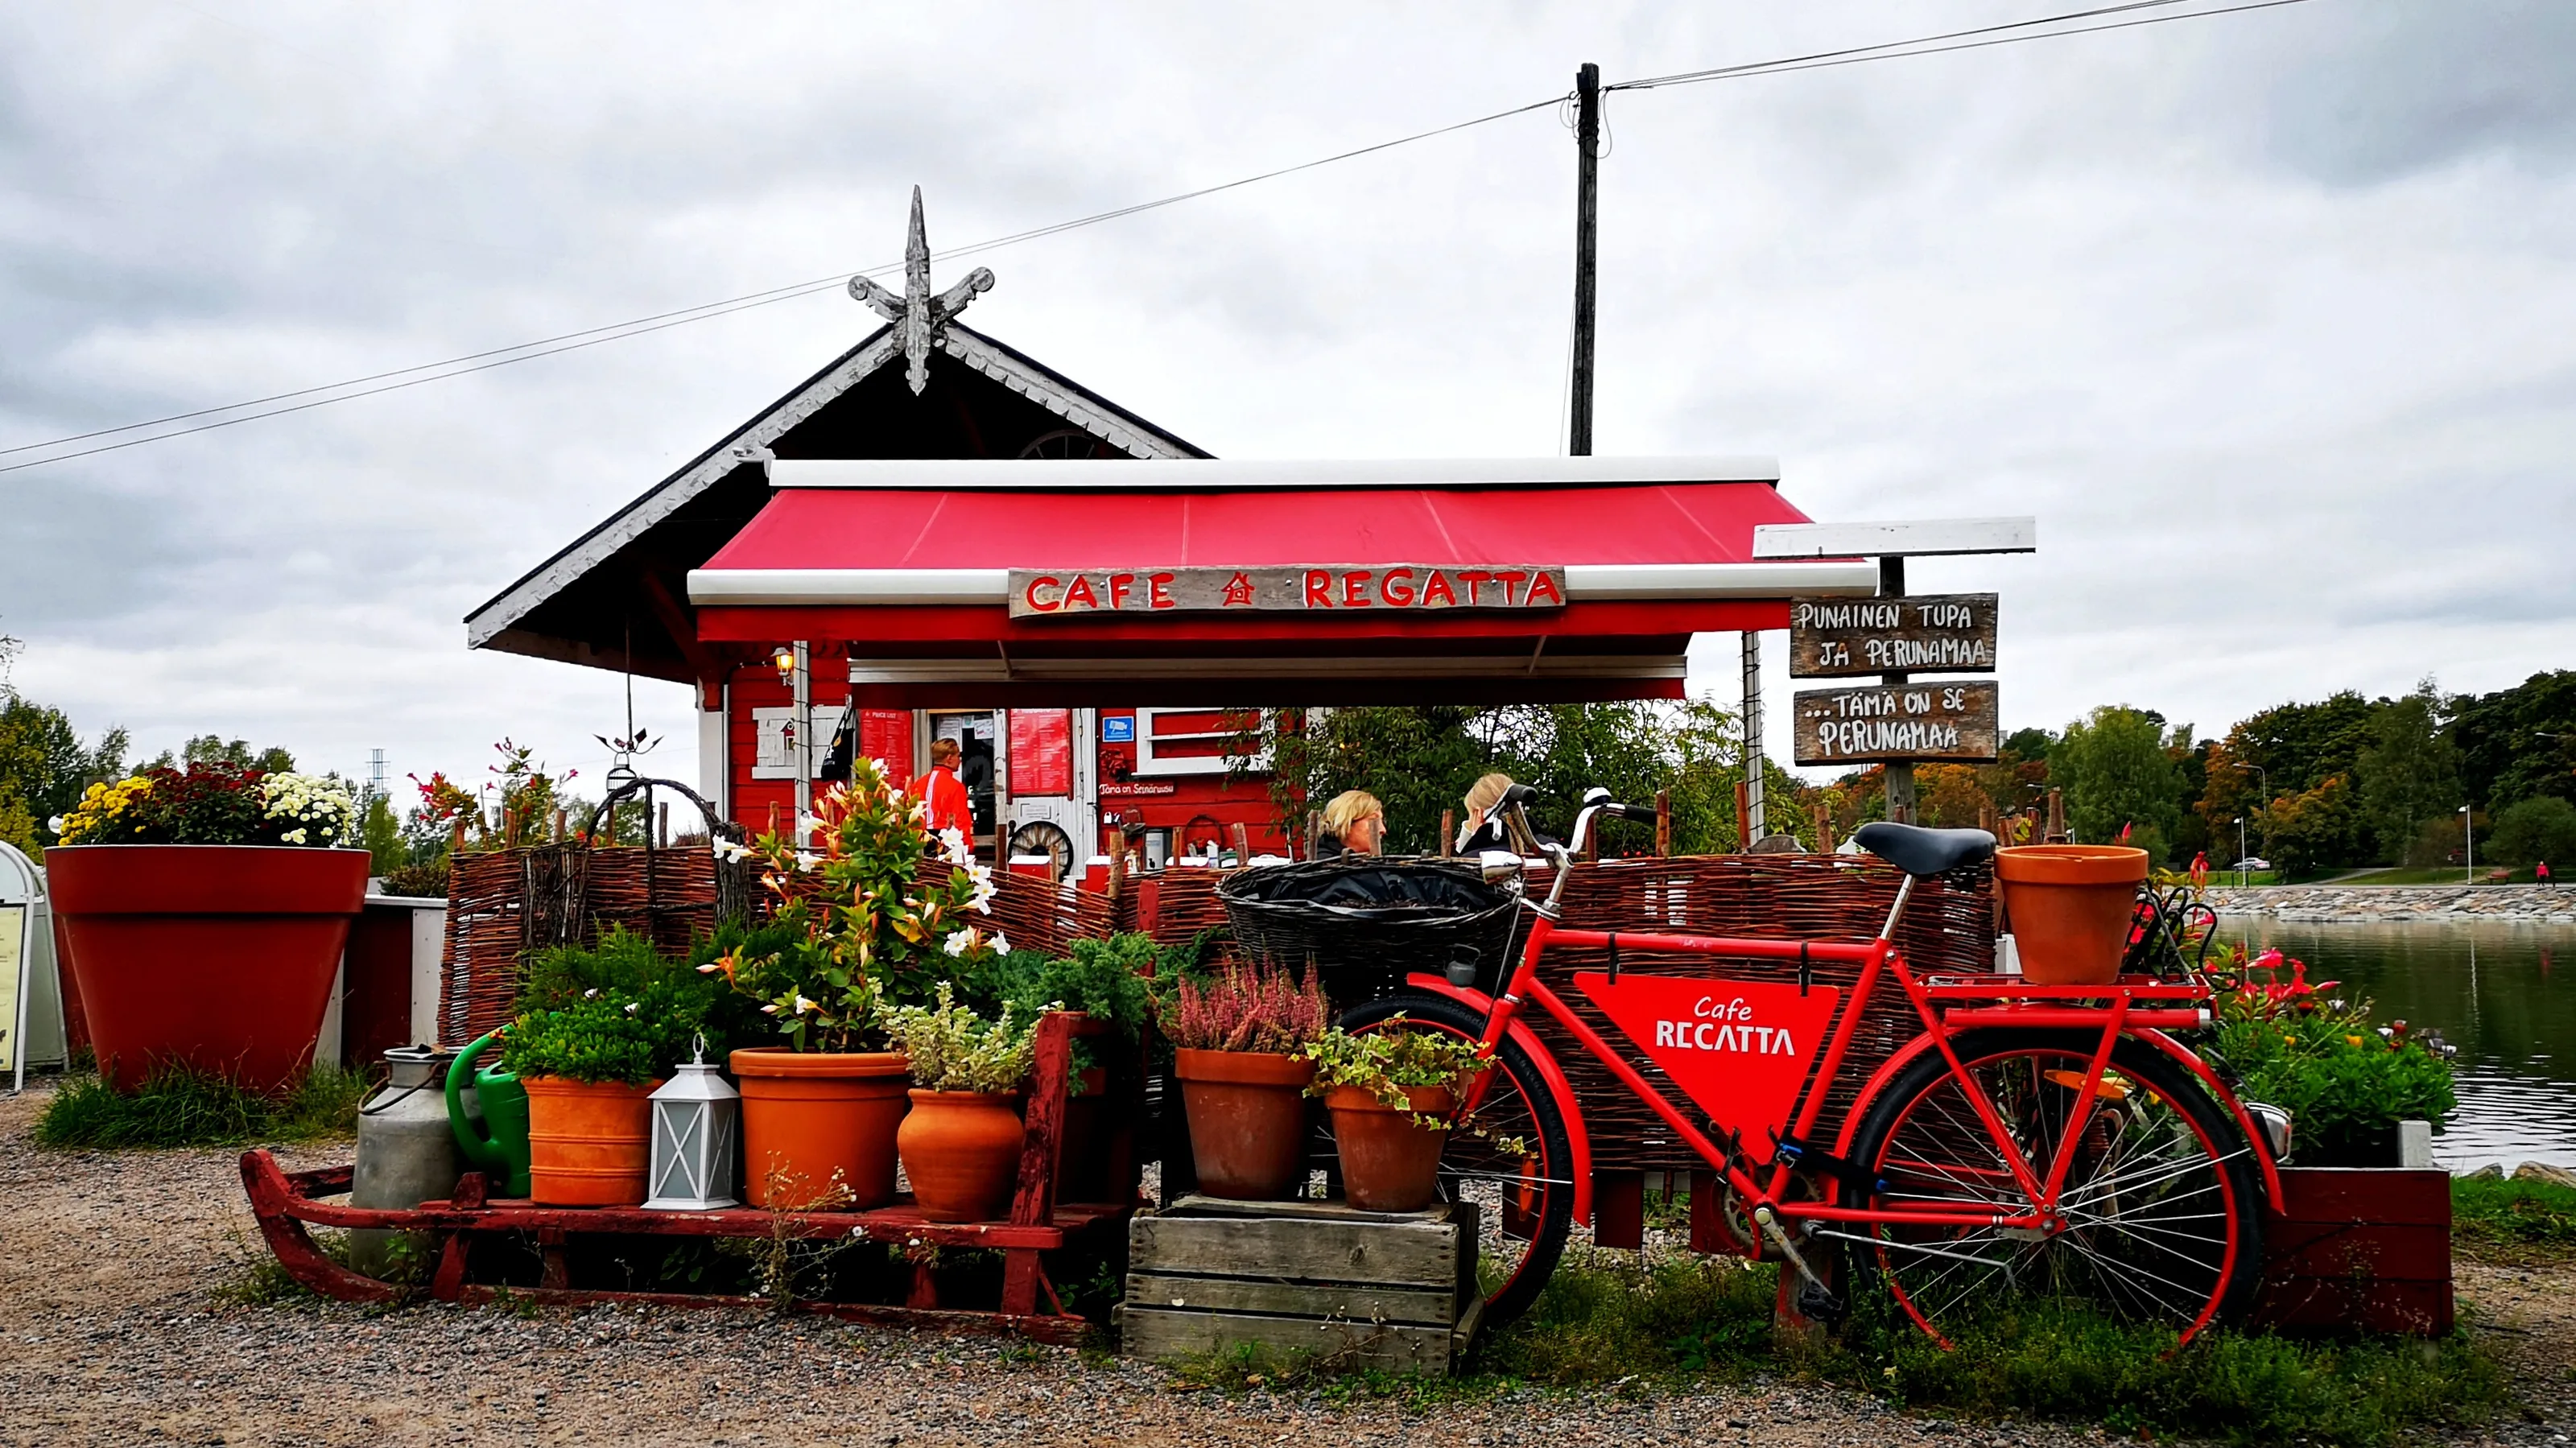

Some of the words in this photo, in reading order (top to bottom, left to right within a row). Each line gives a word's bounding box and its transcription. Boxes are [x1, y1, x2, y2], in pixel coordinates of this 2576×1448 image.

[1026, 572, 1176, 612] CAFE
[1301, 568, 1561, 608] REGATTA
[1798, 604, 1900, 629] PUNAINEN
[1917, 604, 1971, 628] TUPA
[1819, 641, 1849, 666] JA
[1865, 638, 1987, 666] PERUNAMAA
[1905, 692, 1930, 714] ON
[1942, 688, 1965, 712] SE
[1818, 720, 1959, 757] PERUNAMAA
[1121, 786, 1131, 794] on
[1695, 996, 1752, 1021] Cafe
